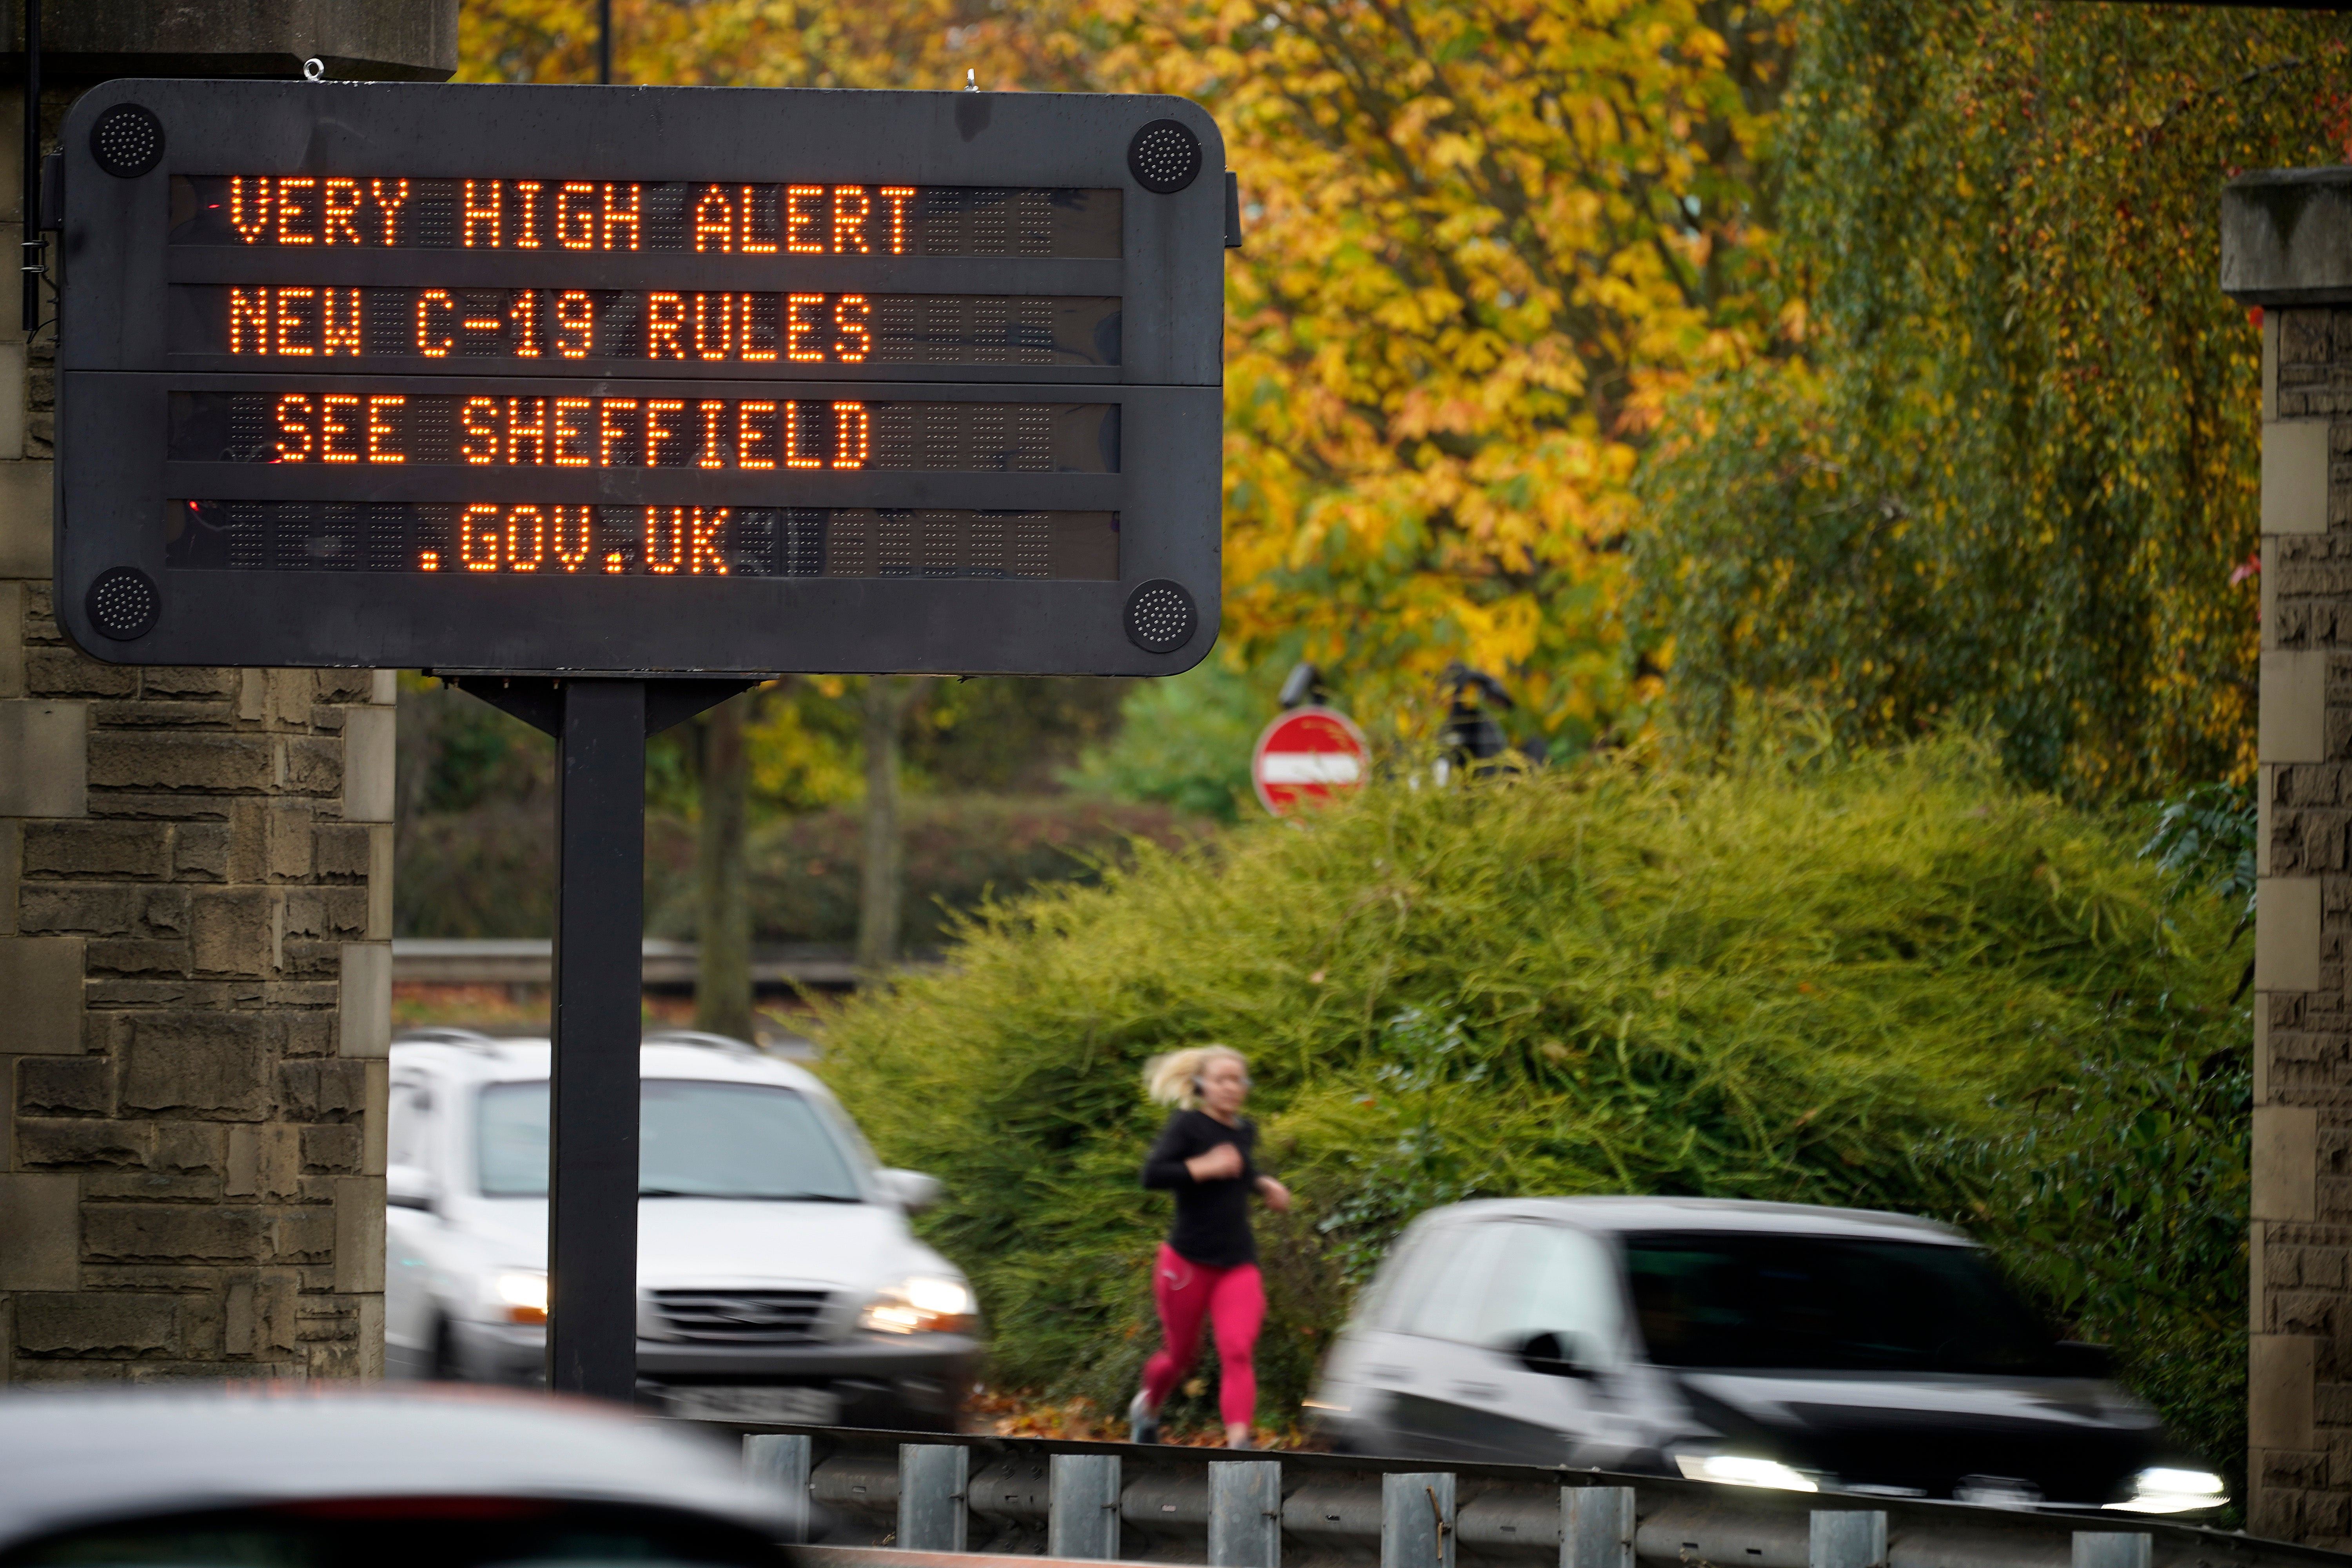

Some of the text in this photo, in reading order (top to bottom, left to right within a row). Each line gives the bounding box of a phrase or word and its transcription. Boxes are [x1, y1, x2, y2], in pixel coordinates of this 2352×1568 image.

[231, 177, 915, 253] VERY HIGH ALERT
[231, 288, 871, 363] NEW C-19 RULES
[275, 396, 869, 468] SEE SHEFFIELD
[421, 504, 728, 574] .GOV.UK
